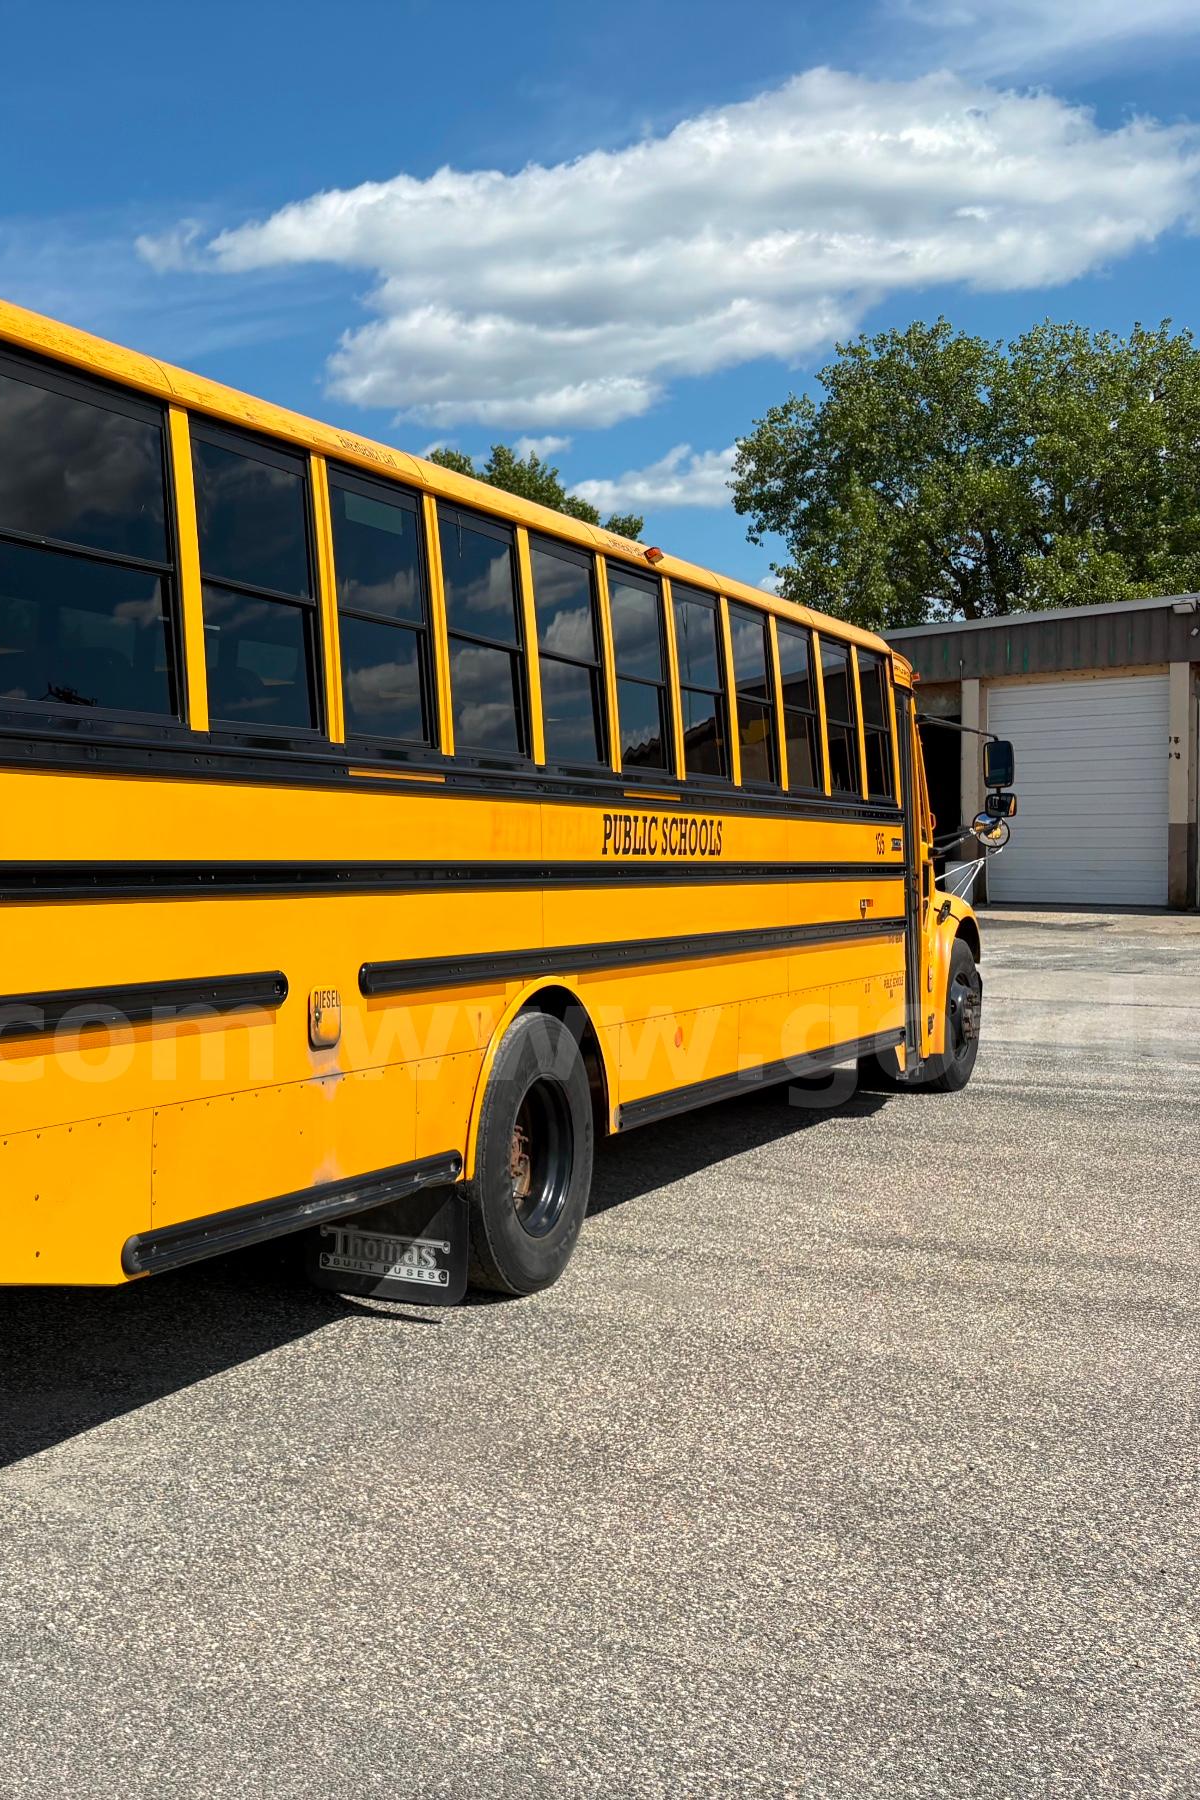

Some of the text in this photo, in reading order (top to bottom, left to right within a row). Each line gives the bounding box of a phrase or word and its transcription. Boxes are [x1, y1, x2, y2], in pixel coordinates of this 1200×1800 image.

[601, 813, 659, 856] PUBLIC
[660, 817, 723, 857] SCHOOLS
[314, 990, 340, 1009] DIESEL
[327, 1225, 445, 1270] Thomas
[332, 1257, 436, 1280] BUILT BUSES
